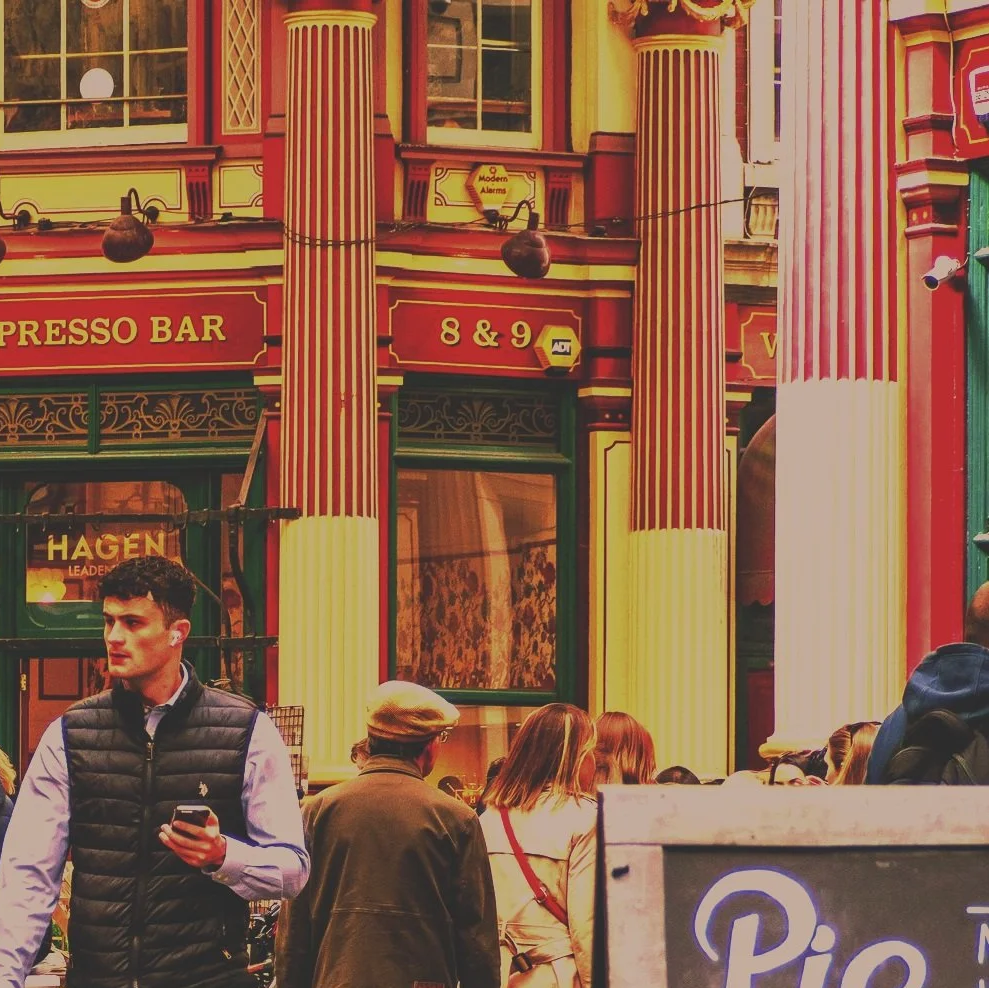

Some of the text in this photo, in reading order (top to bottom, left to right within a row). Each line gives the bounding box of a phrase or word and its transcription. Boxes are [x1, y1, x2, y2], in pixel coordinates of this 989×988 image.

[480, 186, 506, 194] Alarms
[149, 315, 226, 343] BAR
[440, 317, 532, 348] 8 & 9
[551, 340, 571, 354] ADT
[47, 530, 165, 561] HAGEN
